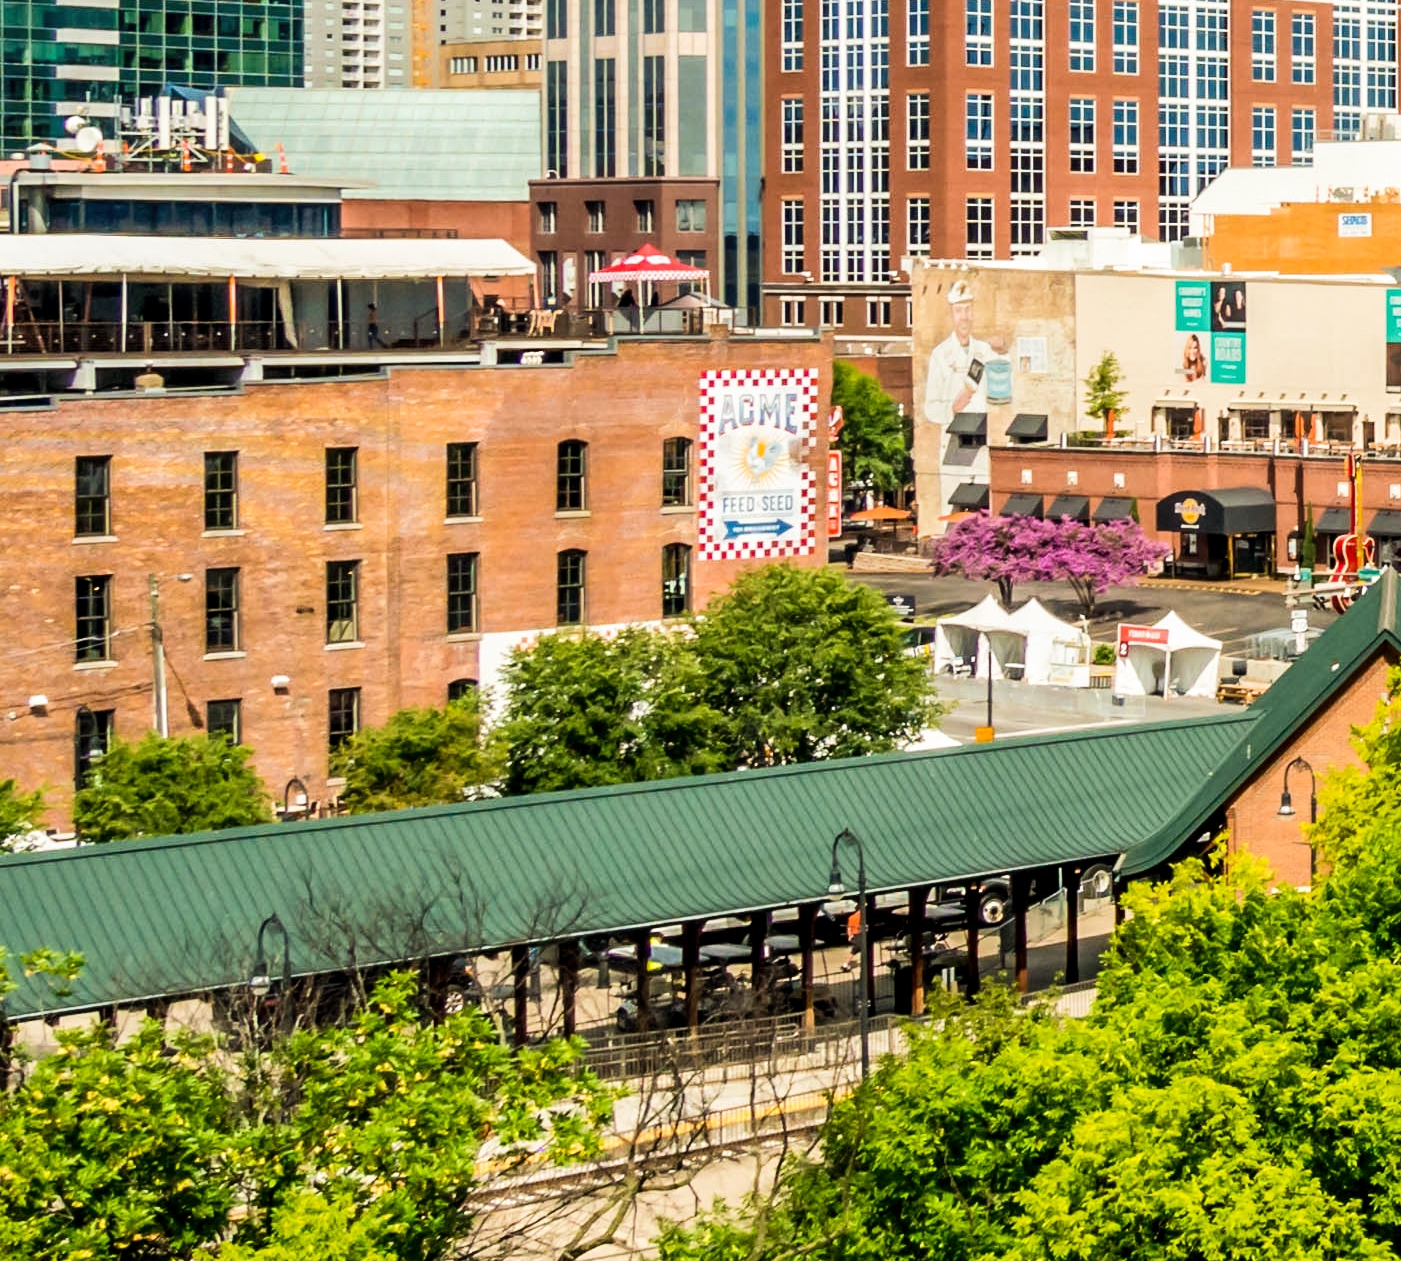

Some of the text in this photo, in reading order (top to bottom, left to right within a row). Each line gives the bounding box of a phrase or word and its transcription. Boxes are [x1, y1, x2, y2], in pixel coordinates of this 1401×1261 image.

[718, 393, 798, 436] ACME
[722, 495, 793, 513] FEED SEED
[1120, 643, 1127, 654] 2
